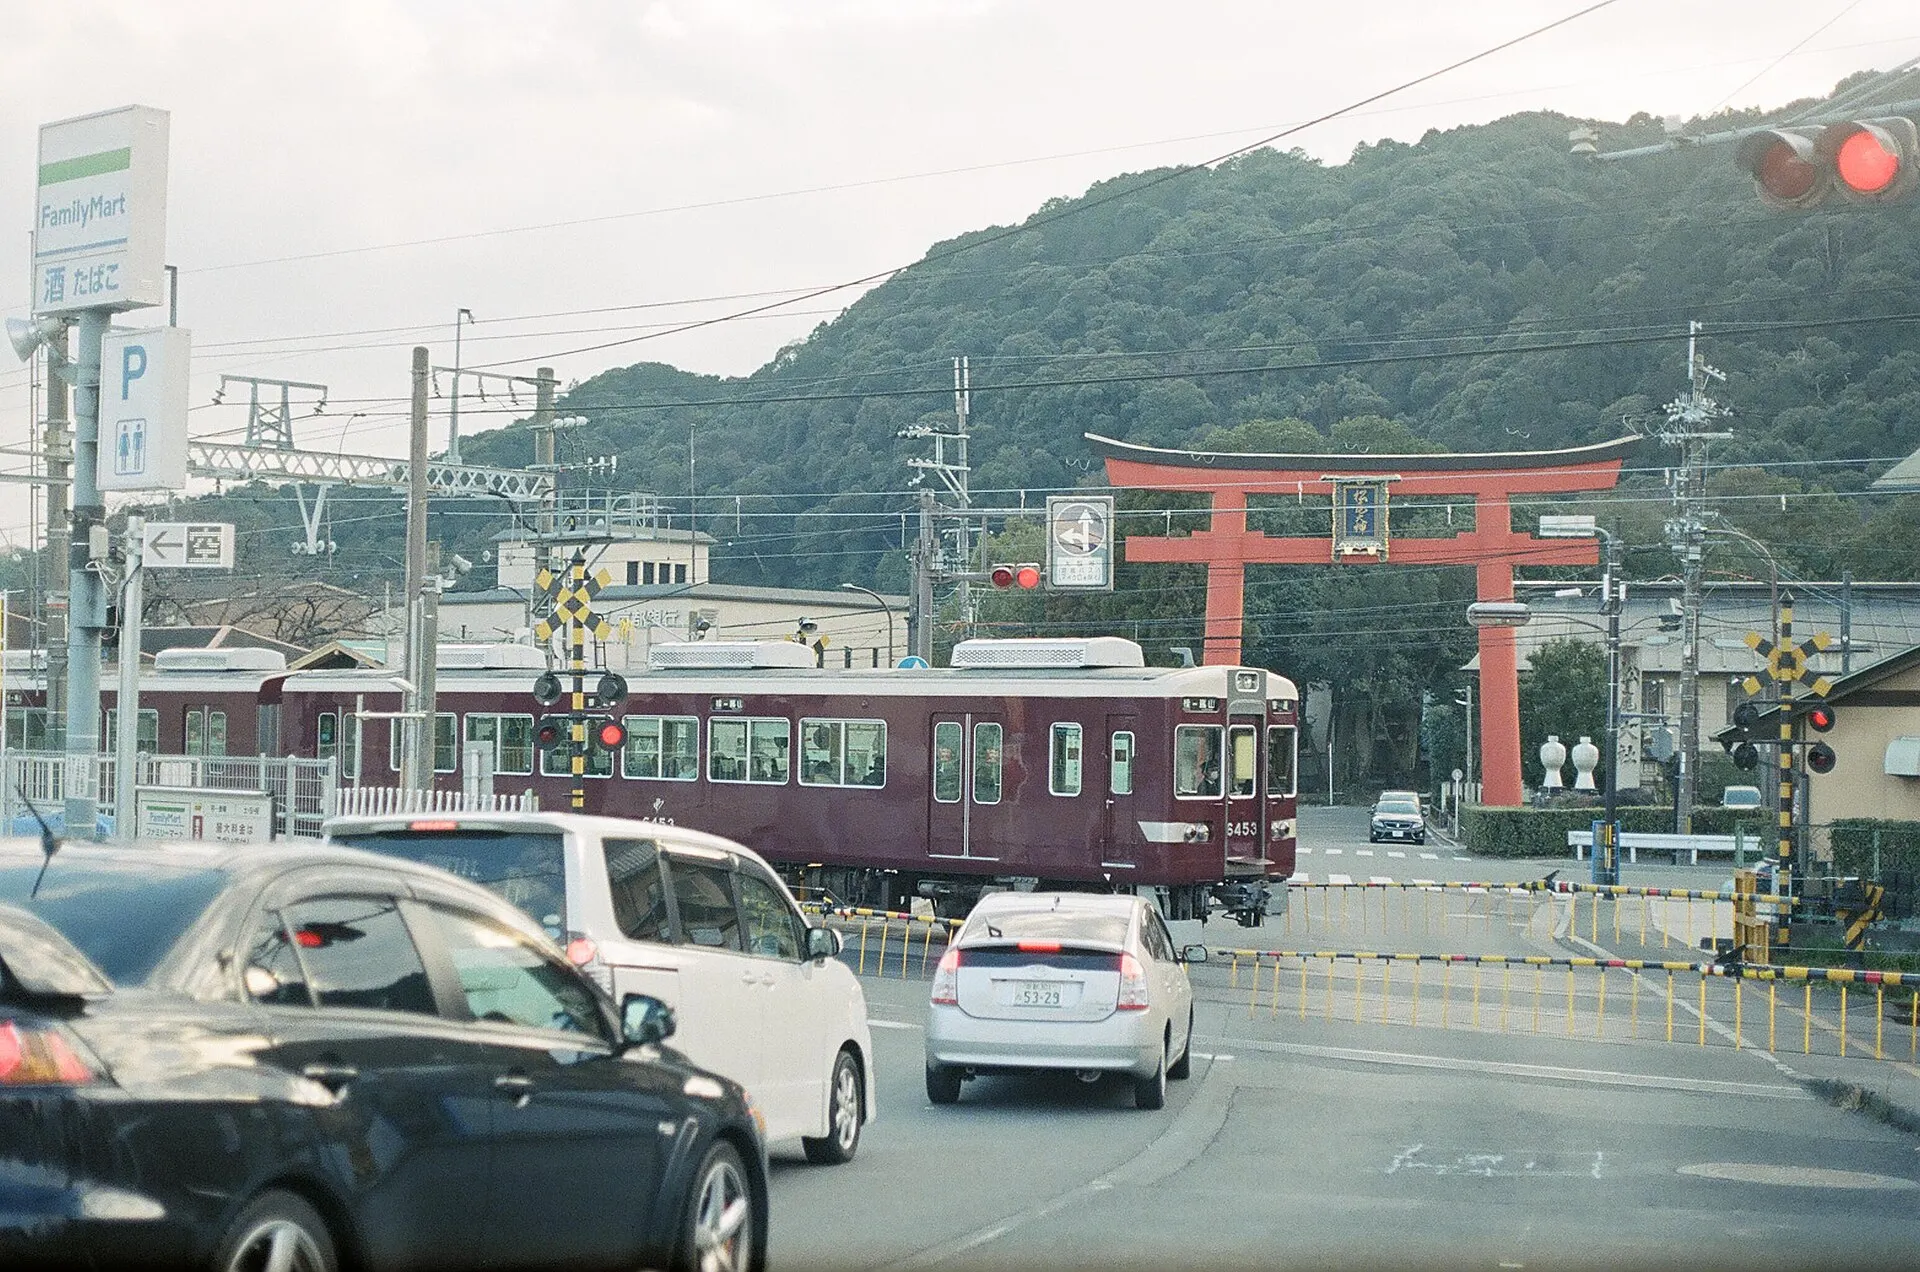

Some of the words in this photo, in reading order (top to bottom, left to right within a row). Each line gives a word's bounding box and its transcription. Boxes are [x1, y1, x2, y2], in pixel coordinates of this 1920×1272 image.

[41, 192, 126, 229] FamilyMart
[44, 266, 66, 304] 酒
[73, 263, 120, 296] たばこ
[121, 344, 147, 401] P
[1227, 822, 1257, 837] 6453
